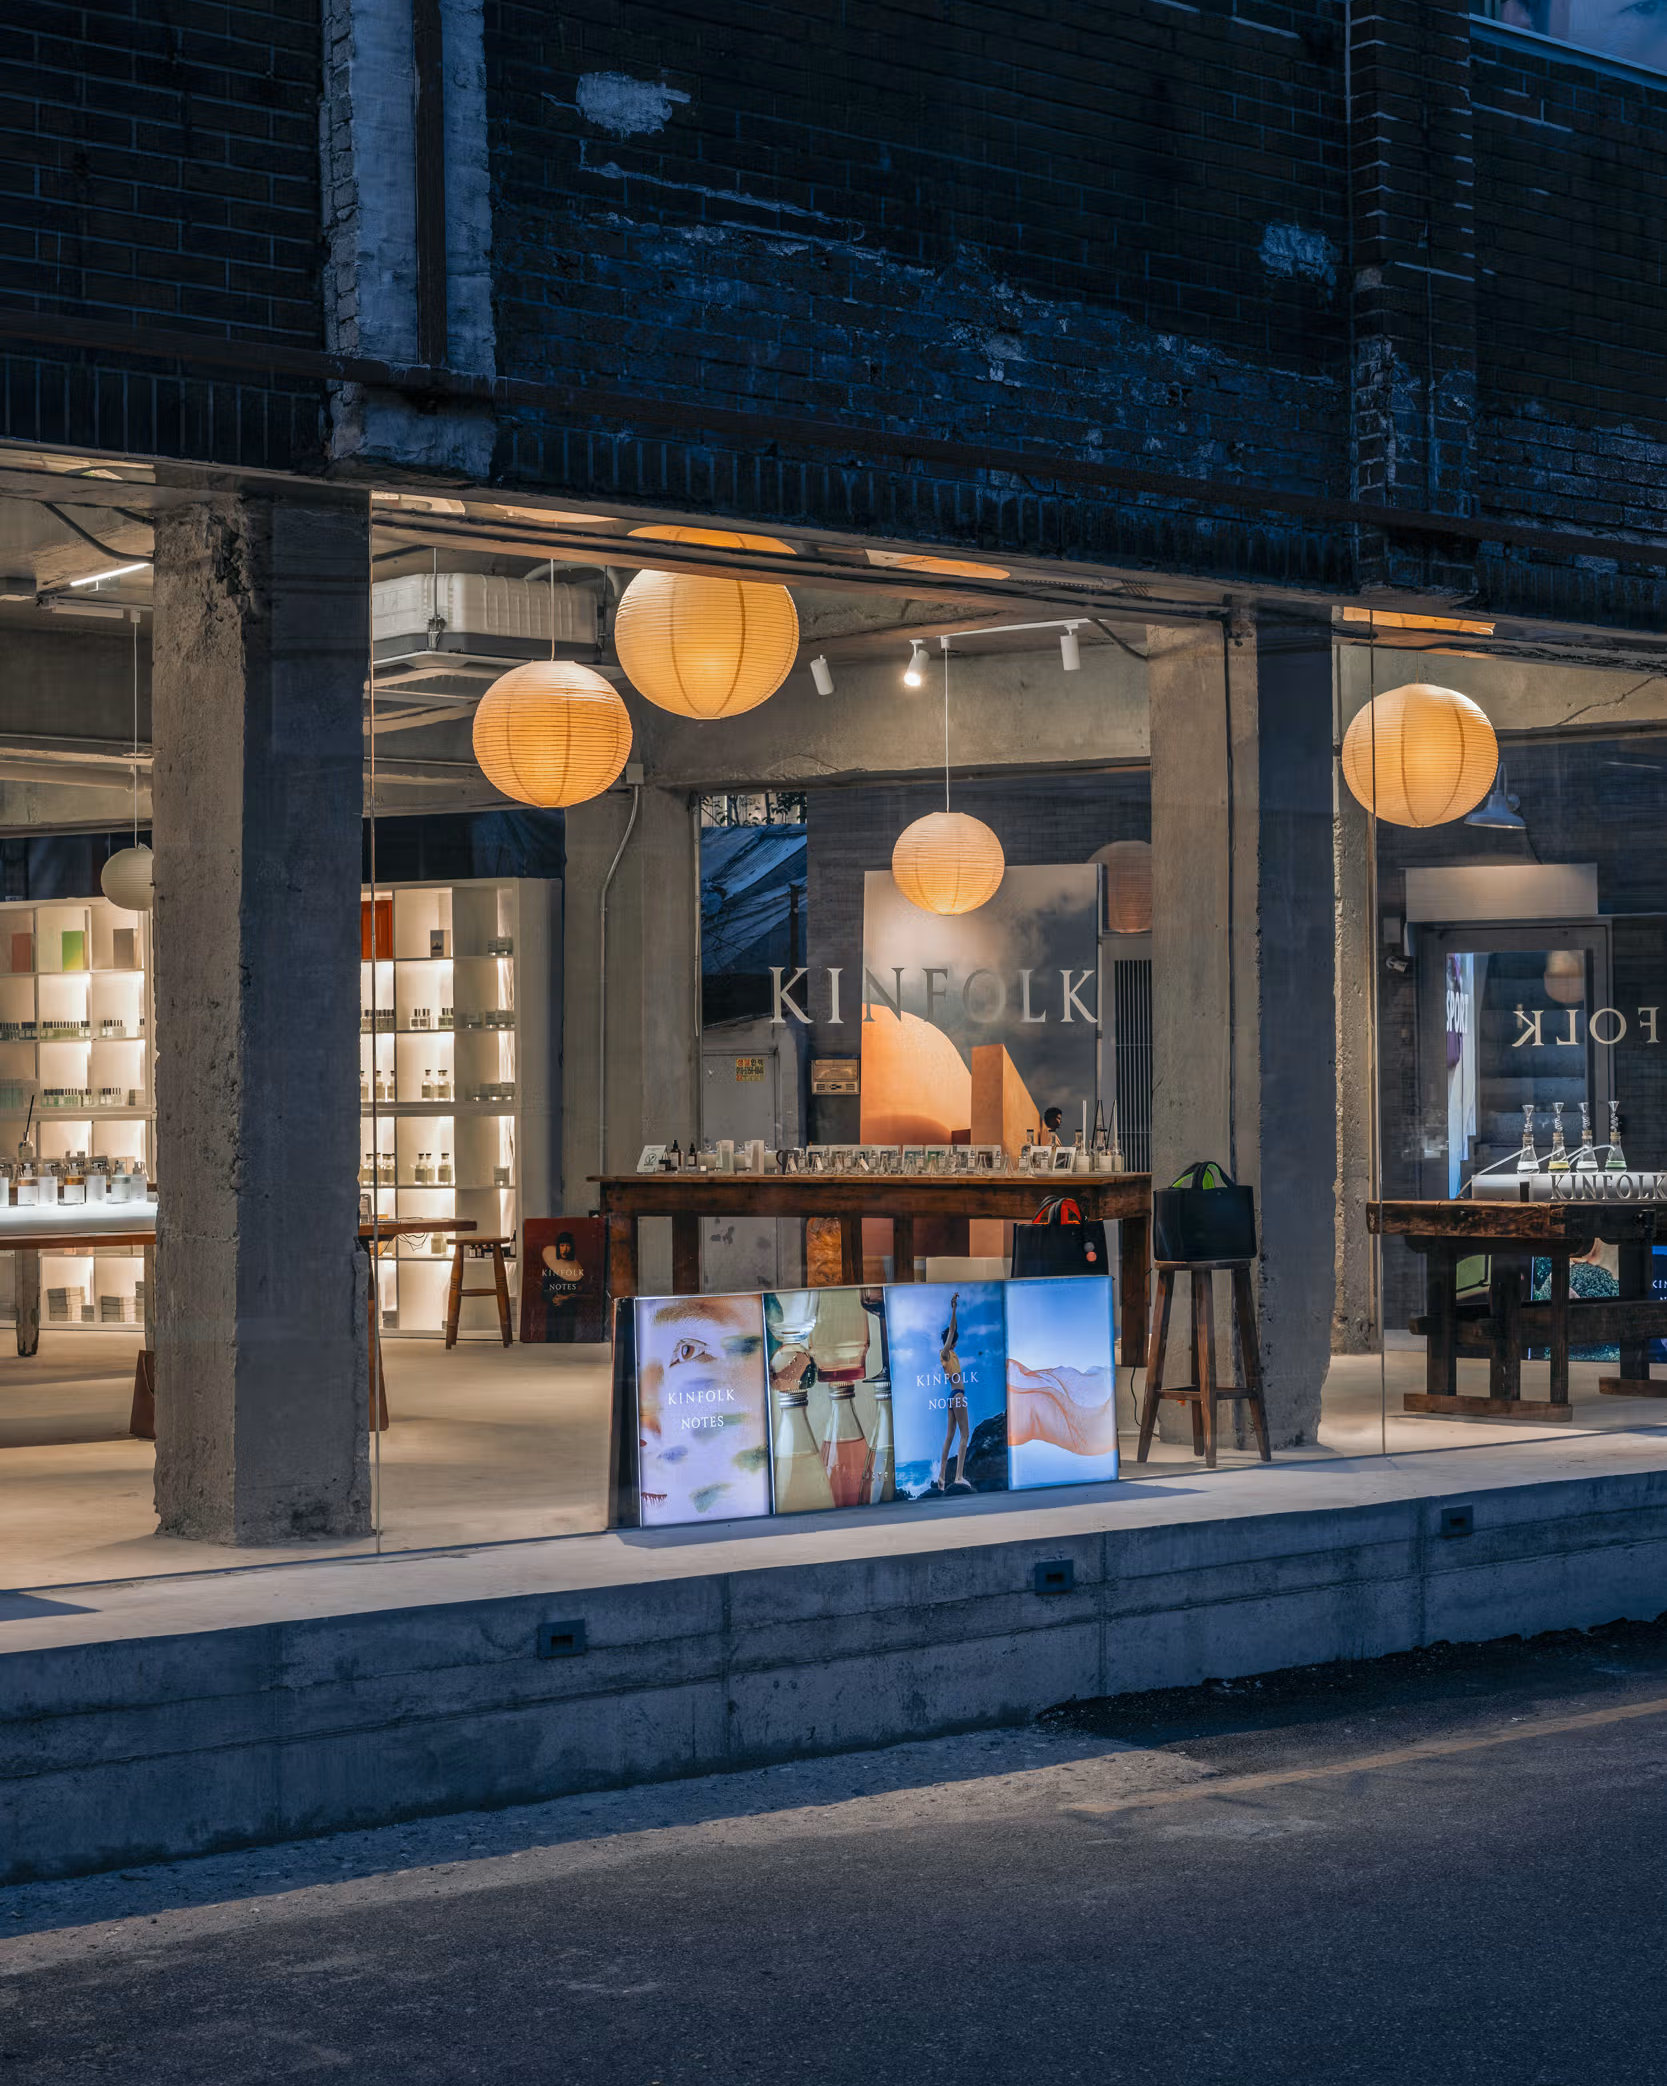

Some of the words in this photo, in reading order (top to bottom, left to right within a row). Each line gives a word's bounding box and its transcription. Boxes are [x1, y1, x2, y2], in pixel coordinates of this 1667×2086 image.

[768, 966, 1099, 1024] KINFOLK
[1446, 989, 1469, 1034] SPORT
[1550, 1174, 1667, 1200] KINFOLK
[541, 1268, 584, 1277] KINFOLK
[549, 1283, 577, 1291] NOTES
[916, 1371, 979, 1387] KINFOLK
[668, 1388, 735, 1405] KINFOLK
[928, 1396, 968, 1410] NOTES
[681, 1415, 724, 1430] NOTES
